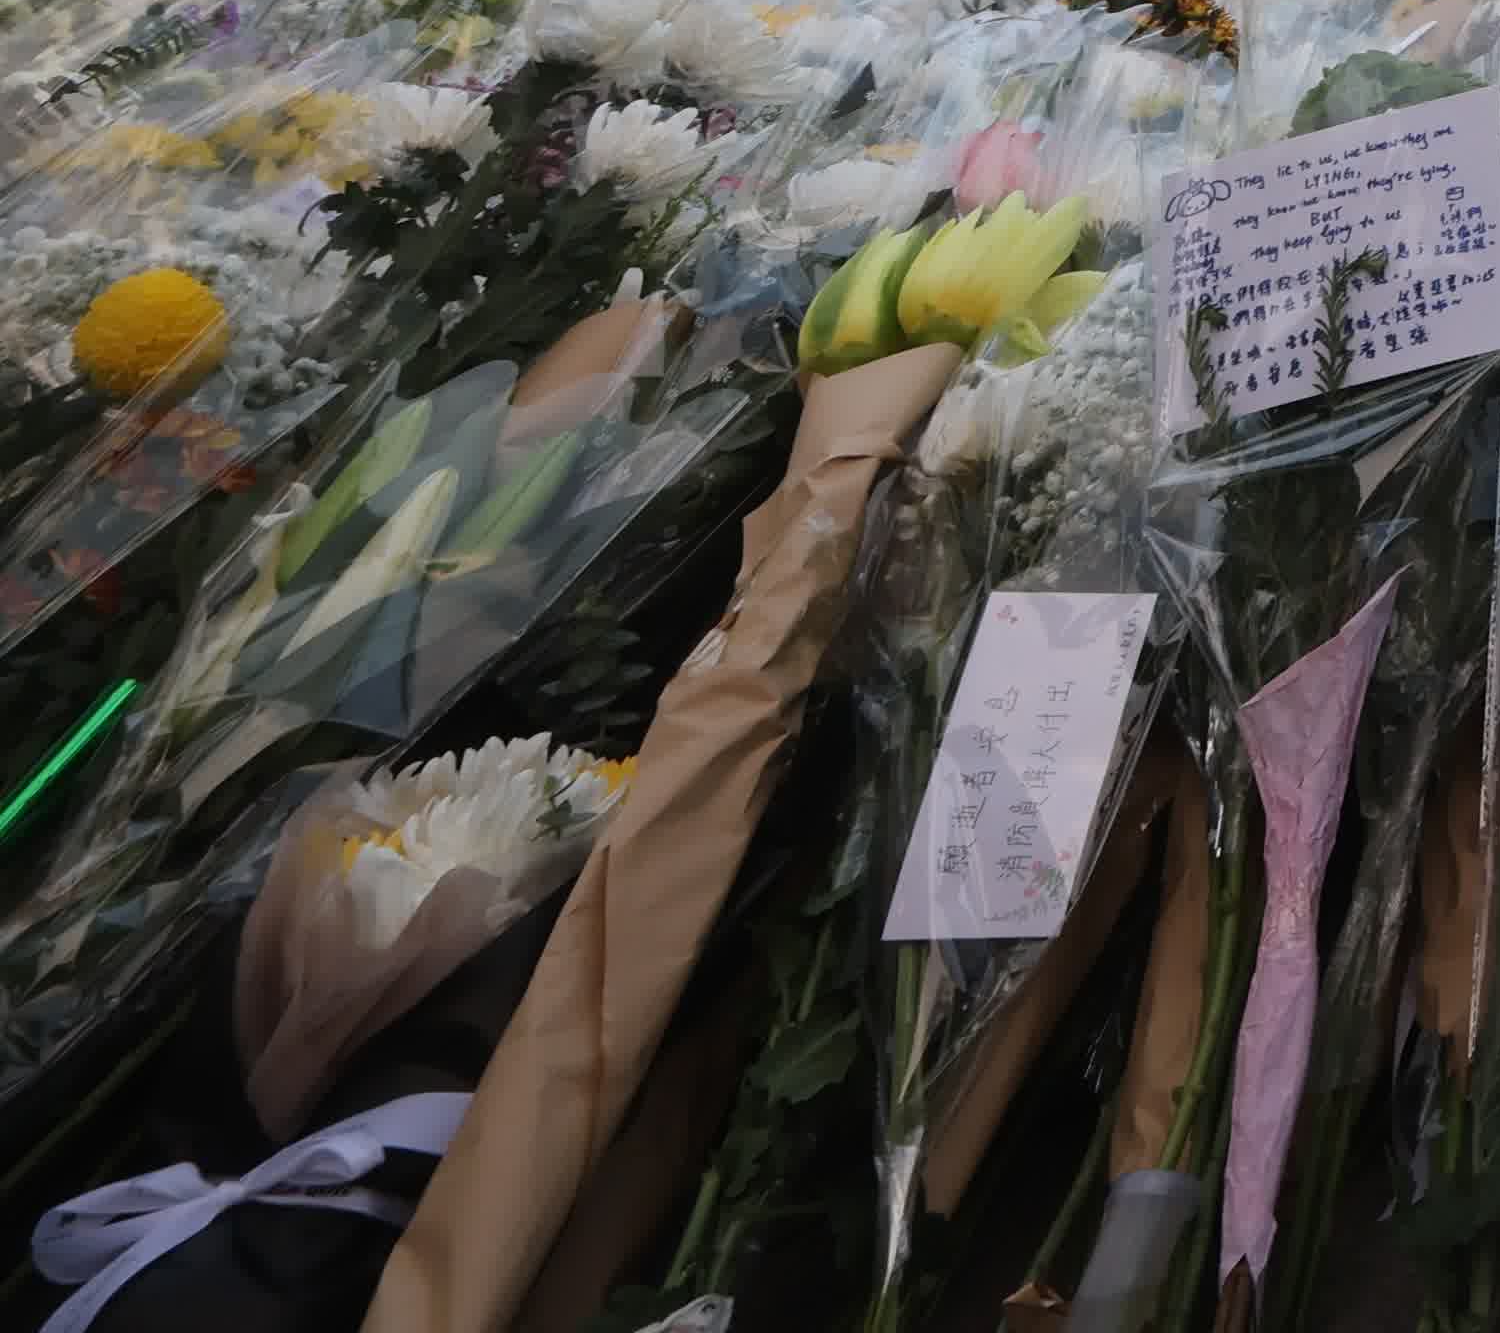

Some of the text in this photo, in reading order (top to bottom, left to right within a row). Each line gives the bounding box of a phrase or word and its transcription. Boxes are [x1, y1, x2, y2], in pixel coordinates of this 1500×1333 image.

[1276, 165, 1294, 179] lie
[1298, 159, 1312, 173] to
[1344, 148, 1361, 160] we
[1250, 243, 1280, 262] they
[1320, 224, 1353, 247] lying
[1360, 214, 1376, 229] to
[1385, 209, 1402, 222] us
